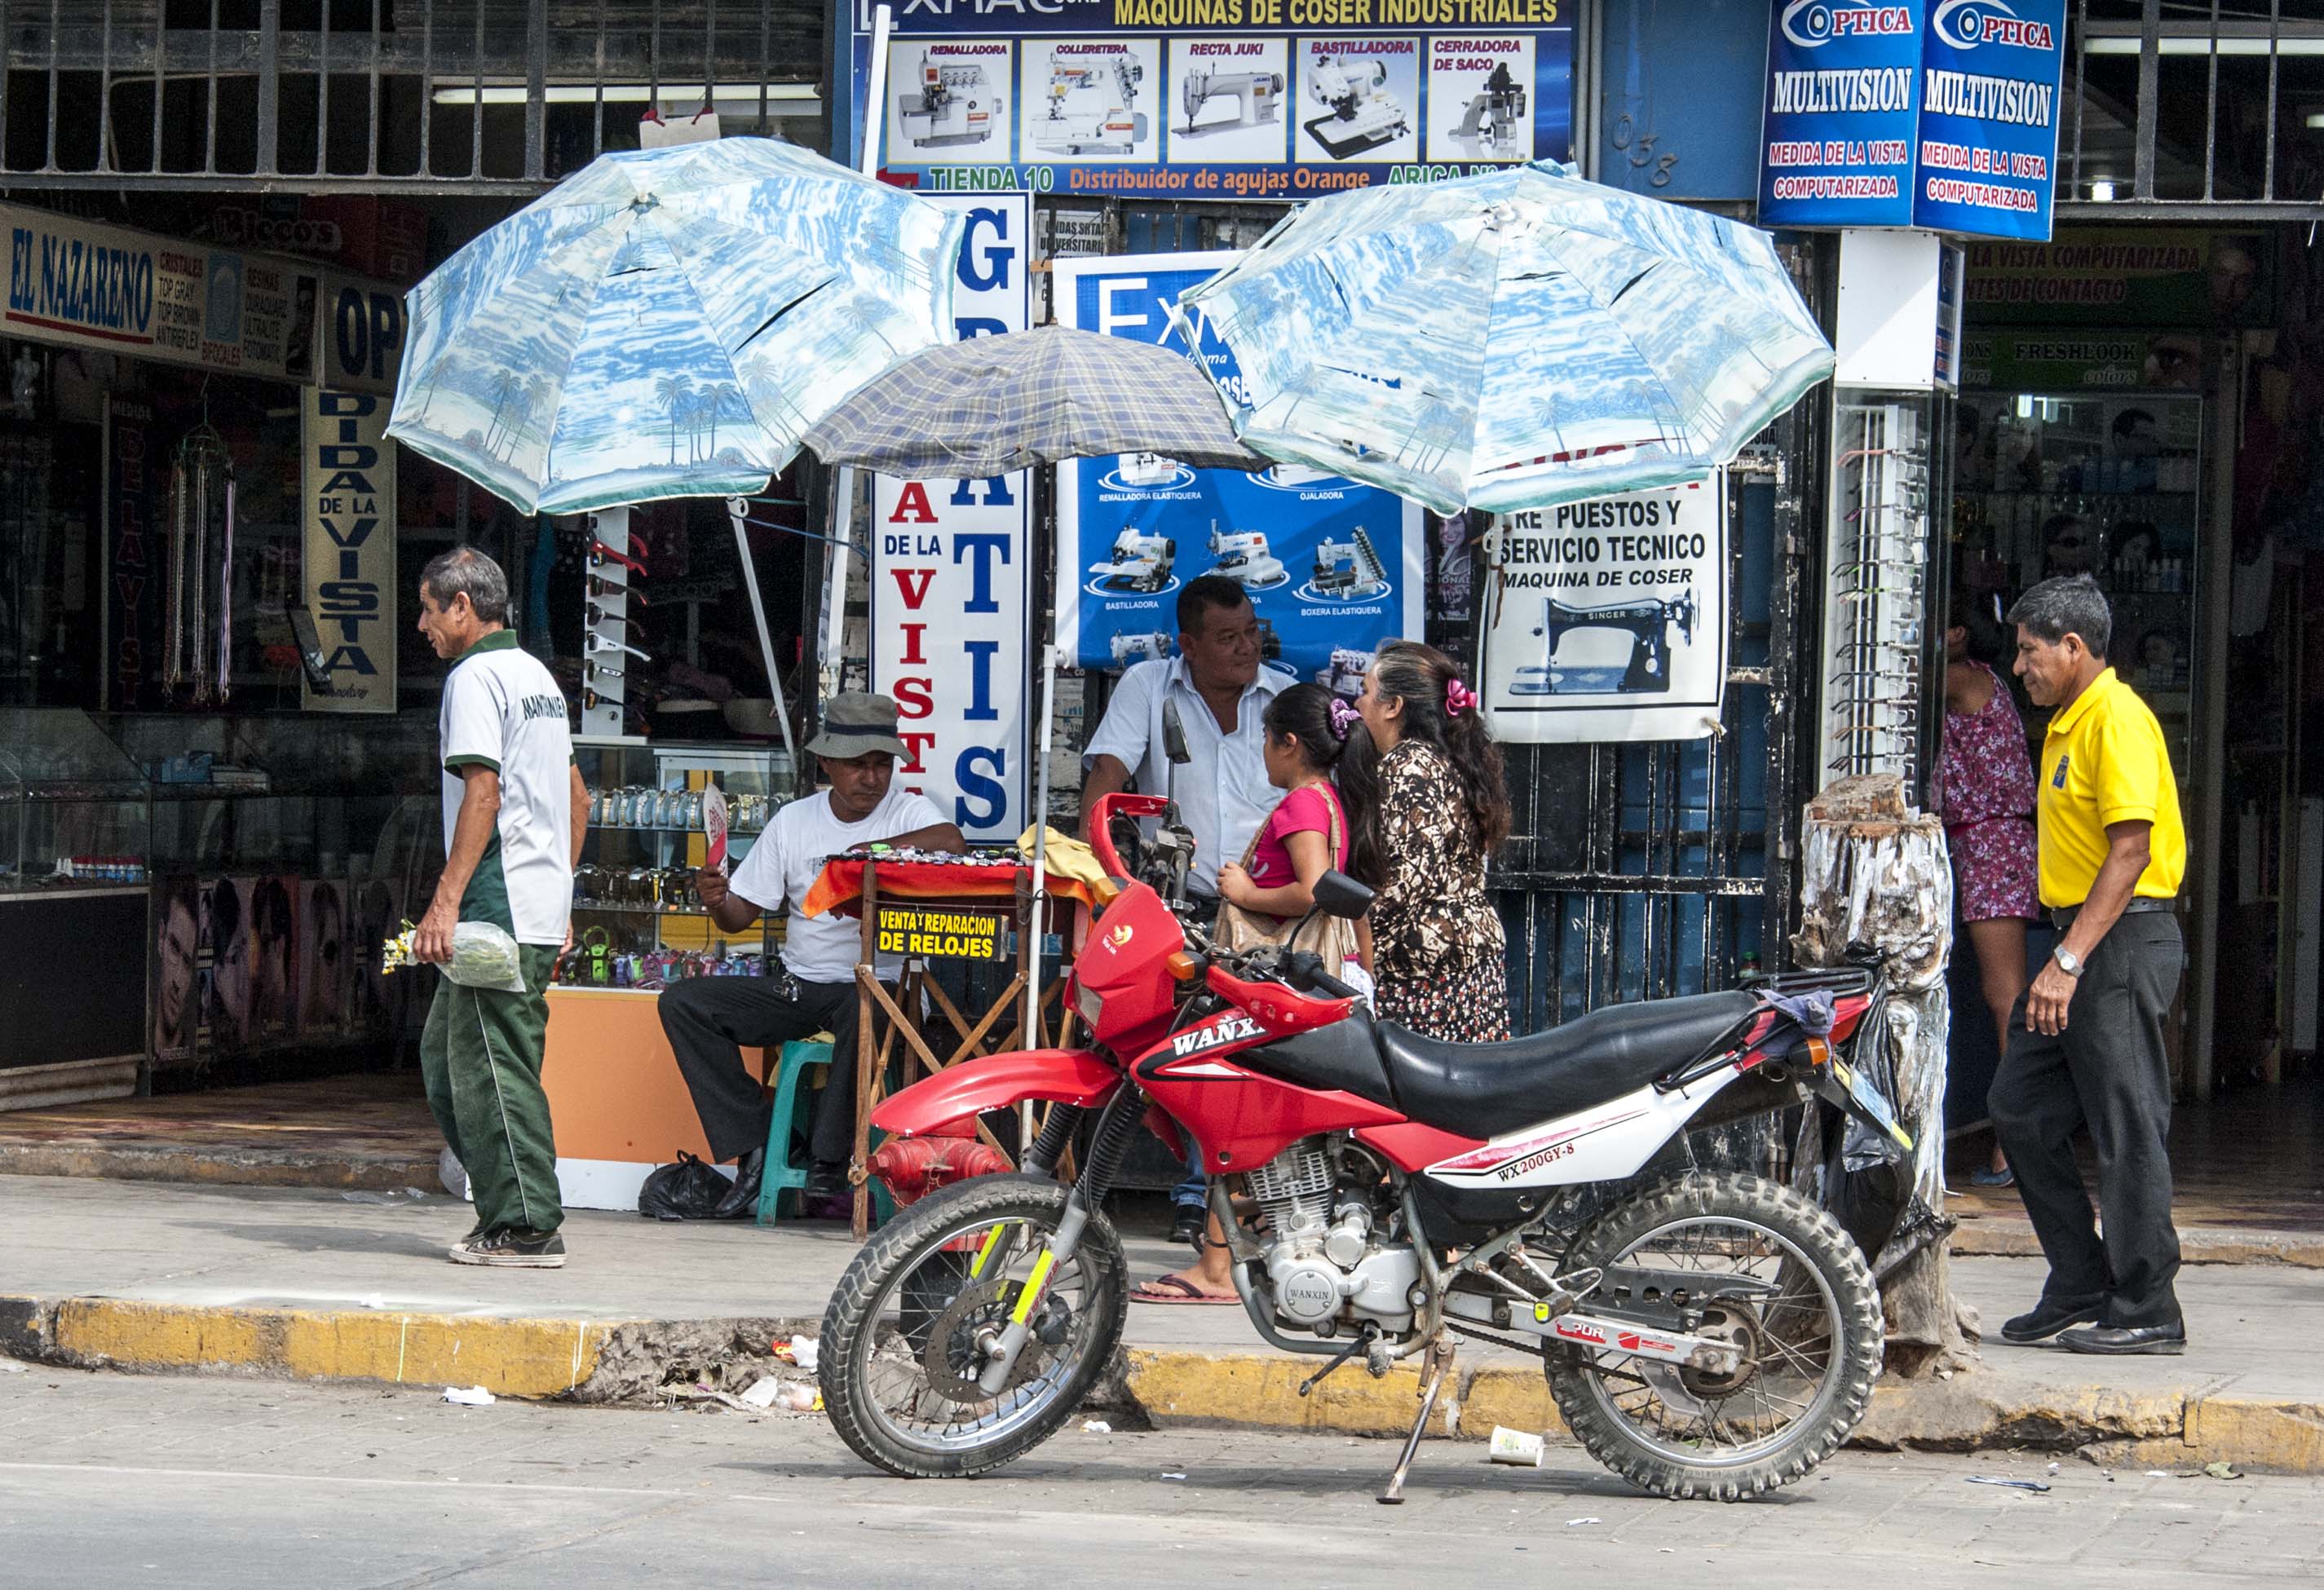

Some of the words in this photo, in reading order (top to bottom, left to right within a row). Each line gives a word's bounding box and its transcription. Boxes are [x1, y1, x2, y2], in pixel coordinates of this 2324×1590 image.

[1114, 0, 1243, 26] MAQUINAS
[1250, 0, 1282, 24] DE
[1289, 0, 1370, 24] COSER
[1379, 0, 1558, 24] INDUSTRIALES
[930, 44, 1008, 55] REMALLADORA
[1056, 44, 1129, 55] COLLERETERA
[1190, 44, 1232, 55] RECTA
[1235, 43, 1265, 55] JUKI
[1310, 41, 1414, 55] BASTILLADORA
[1434, 40, 1522, 54] CERRADORA
[1434, 58, 1454, 71] DE
[1456, 58, 1494, 71] SACO
[1772, 68, 1913, 113] MULTIVISION
[1924, 68, 2052, 127] MULTIVISION
[1769, 142, 1822, 166] MEDIDA
[1825, 143, 1845, 166] DE
[1846, 142, 1865, 165] LA
[1868, 140, 1908, 165] VISTA
[1922, 141, 1969, 170] MEDIDA
[1972, 148, 1991, 173] DE
[1991, 149, 2009, 174] LA
[2010, 152, 2048, 180] VISTA
[929, 167, 1019, 191] TIENDA
[1025, 166, 1054, 191] 10
[1070, 168, 1189, 189] Distribuidor
[1194, 168, 1217, 189] de
[1223, 169, 1288, 195] agujas
[1293, 168, 1371, 190] Orange
[1388, 165, 1463, 185] ARICA
[1774, 175, 1898, 200] COMPUTARIZADA
[1927, 178, 2038, 214] COMPUTARIZADA
[1045, 220, 1077, 235] LDAS
[160, 253, 203, 279] CRISTALES
[1971, 246, 1992, 268] LA
[1998, 246, 2048, 268] VISTA
[10, 228, 35, 312] EL
[39, 233, 153, 333] NAZARENO
[159, 277, 173, 297] TOP
[175, 280, 196, 301] GRAY
[157, 300, 172, 321] TOP
[337, 287, 402, 379] OP
[2015, 342, 2138, 360] FRESHLOOK
[319, 497, 342, 515] DE
[353, 497, 377, 515] LA
[1099, 492, 1151, 501] REMALLADORA
[1152, 491, 1202, 501] ELASTIQUERA
[1300, 492, 1344, 501] OJALADORA
[950, 208, 1015, 828] GTIS
[1557, 500, 1659, 529] PUESTOS
[1666, 500, 1681, 525] Y
[885, 534, 910, 556] DE
[917, 534, 942, 556] LA
[1500, 537, 1600, 564] SERVICIO
[1607, 533, 1705, 562] TECNICO
[1502, 571, 1590, 589] MAQUINA
[1596, 570, 1622, 586] DE
[1629, 568, 1693, 585] COSER
[319, 518, 379, 675] VISTA
[1105, 601, 1159, 611] BASTILLADORA
[1301, 607, 1331, 616] BOXERA
[1332, 606, 1382, 616] ELASTIQUERA
[1588, 611, 1626, 620] SINGER
[890, 568, 937, 796] VIST
[879, 910, 917, 931] VENTA
[917, 912, 925, 926] Y
[925, 913, 996, 936] REPARACION
[879, 931, 904, 952] DE
[909, 934, 993, 958] RELOJES
[1290, 1288, 1329, 1300] WANXIN
